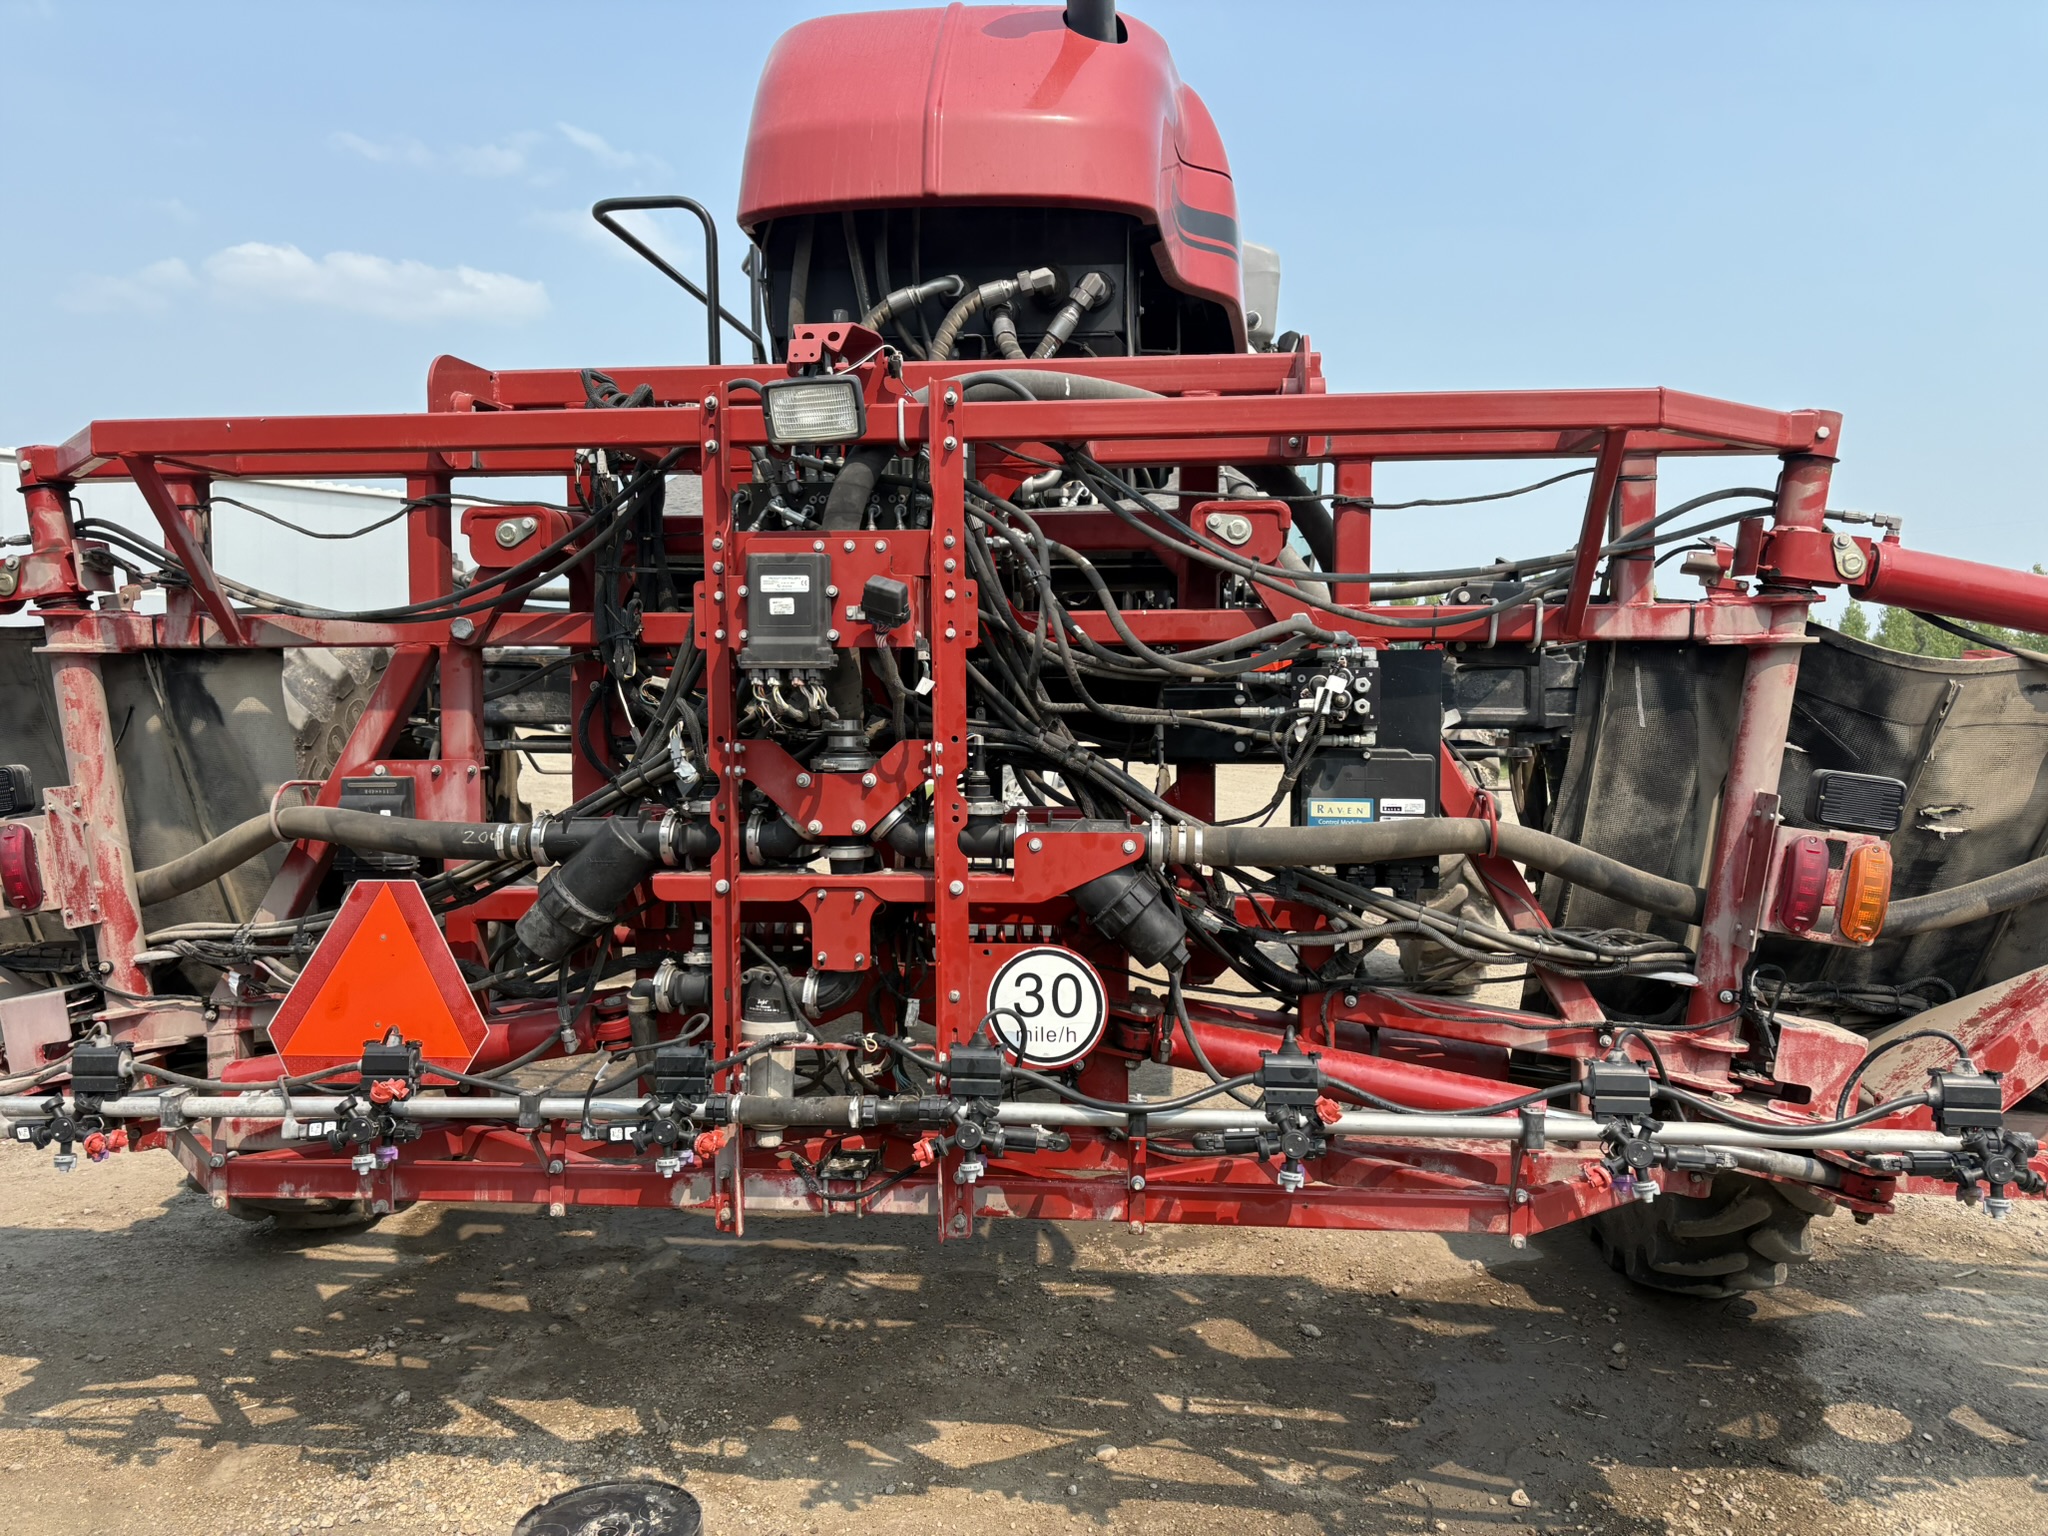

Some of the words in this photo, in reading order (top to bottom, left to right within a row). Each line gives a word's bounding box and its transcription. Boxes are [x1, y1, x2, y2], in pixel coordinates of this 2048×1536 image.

[1317, 804, 1363, 814] RAVEN
[1014, 972, 1083, 1018] 30
[1016, 1026, 1077, 1043] mile/h
